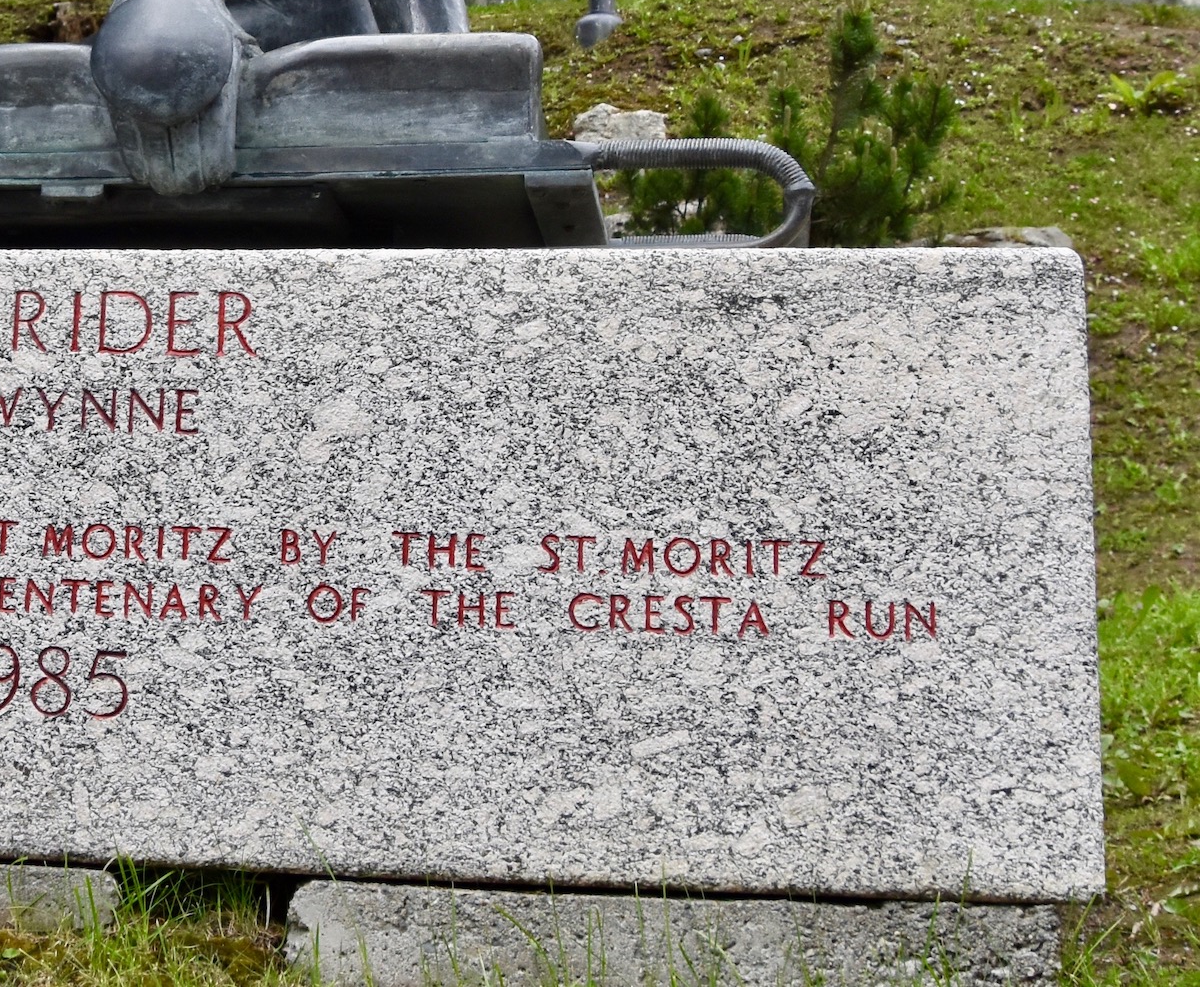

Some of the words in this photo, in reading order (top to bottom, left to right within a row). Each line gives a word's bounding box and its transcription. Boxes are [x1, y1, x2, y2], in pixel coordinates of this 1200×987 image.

[11, 290, 257, 358] RIDER
[42, 523, 233, 564] MORITZ
[280, 528, 337, 566] BY
[392, 530, 486, 573] THE
[621, 536, 826, 579] MORITZ
[306, 582, 368, 624] OF
[422, 589, 515, 630] THE
[568, 592, 769, 639] CRESTA
[827, 599, 937, 641] RUN
